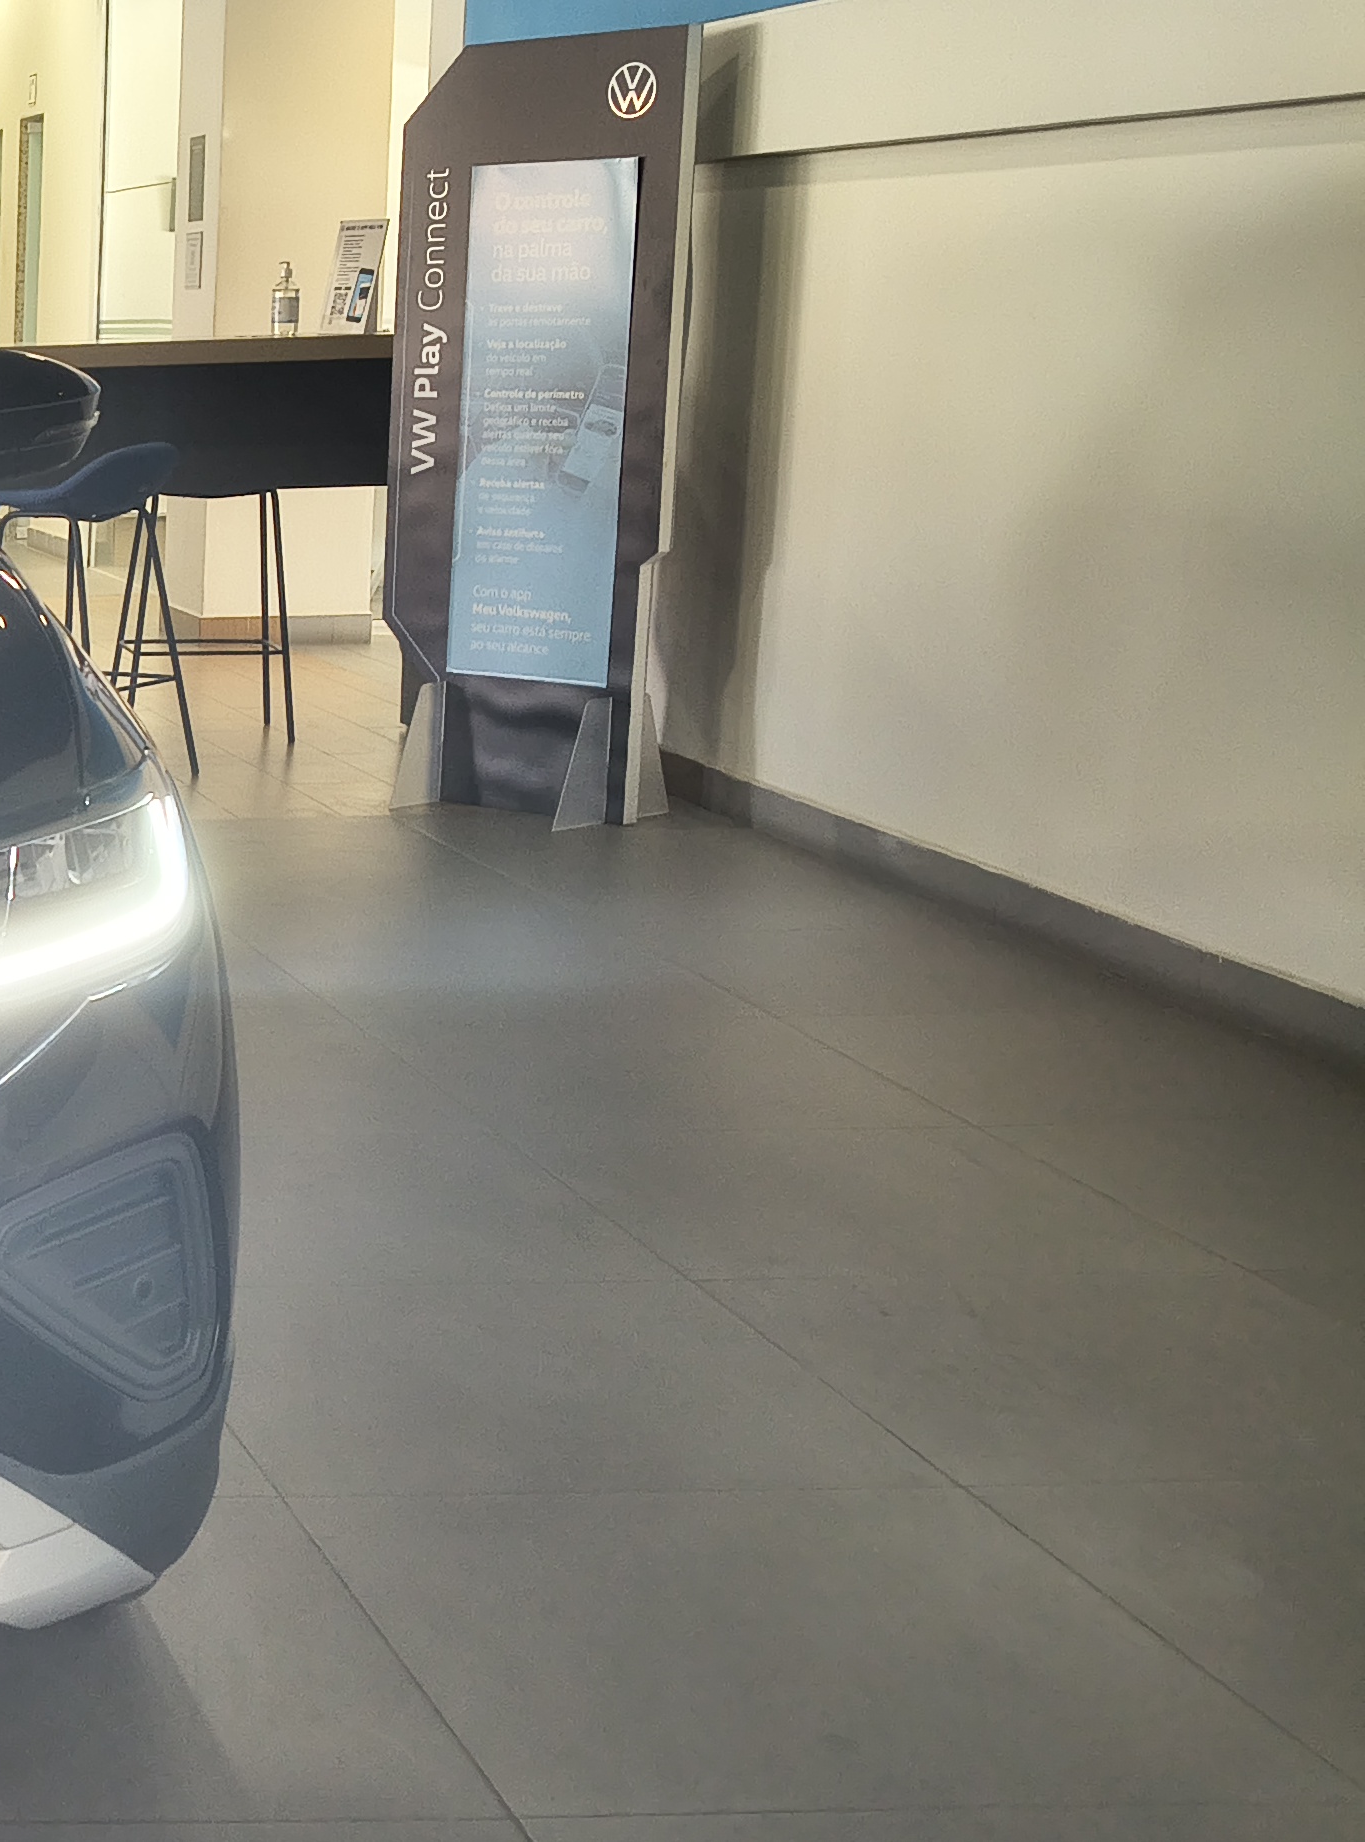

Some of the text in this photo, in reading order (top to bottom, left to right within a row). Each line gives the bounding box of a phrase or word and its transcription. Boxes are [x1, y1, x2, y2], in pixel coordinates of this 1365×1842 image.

[492, 238, 572, 262] na palma
[491, 263, 513, 282] da
[516, 266, 547, 282] sua
[410, 167, 450, 475] VW Play Connect
[516, 339, 567, 351] localização
[484, 388, 523, 398] Controle
[538, 388, 585, 401] perímetro
[472, 584, 498, 598] Com
[472, 603, 571, 625] Meu Volkswagen,
[548, 628, 591, 643] sempre
